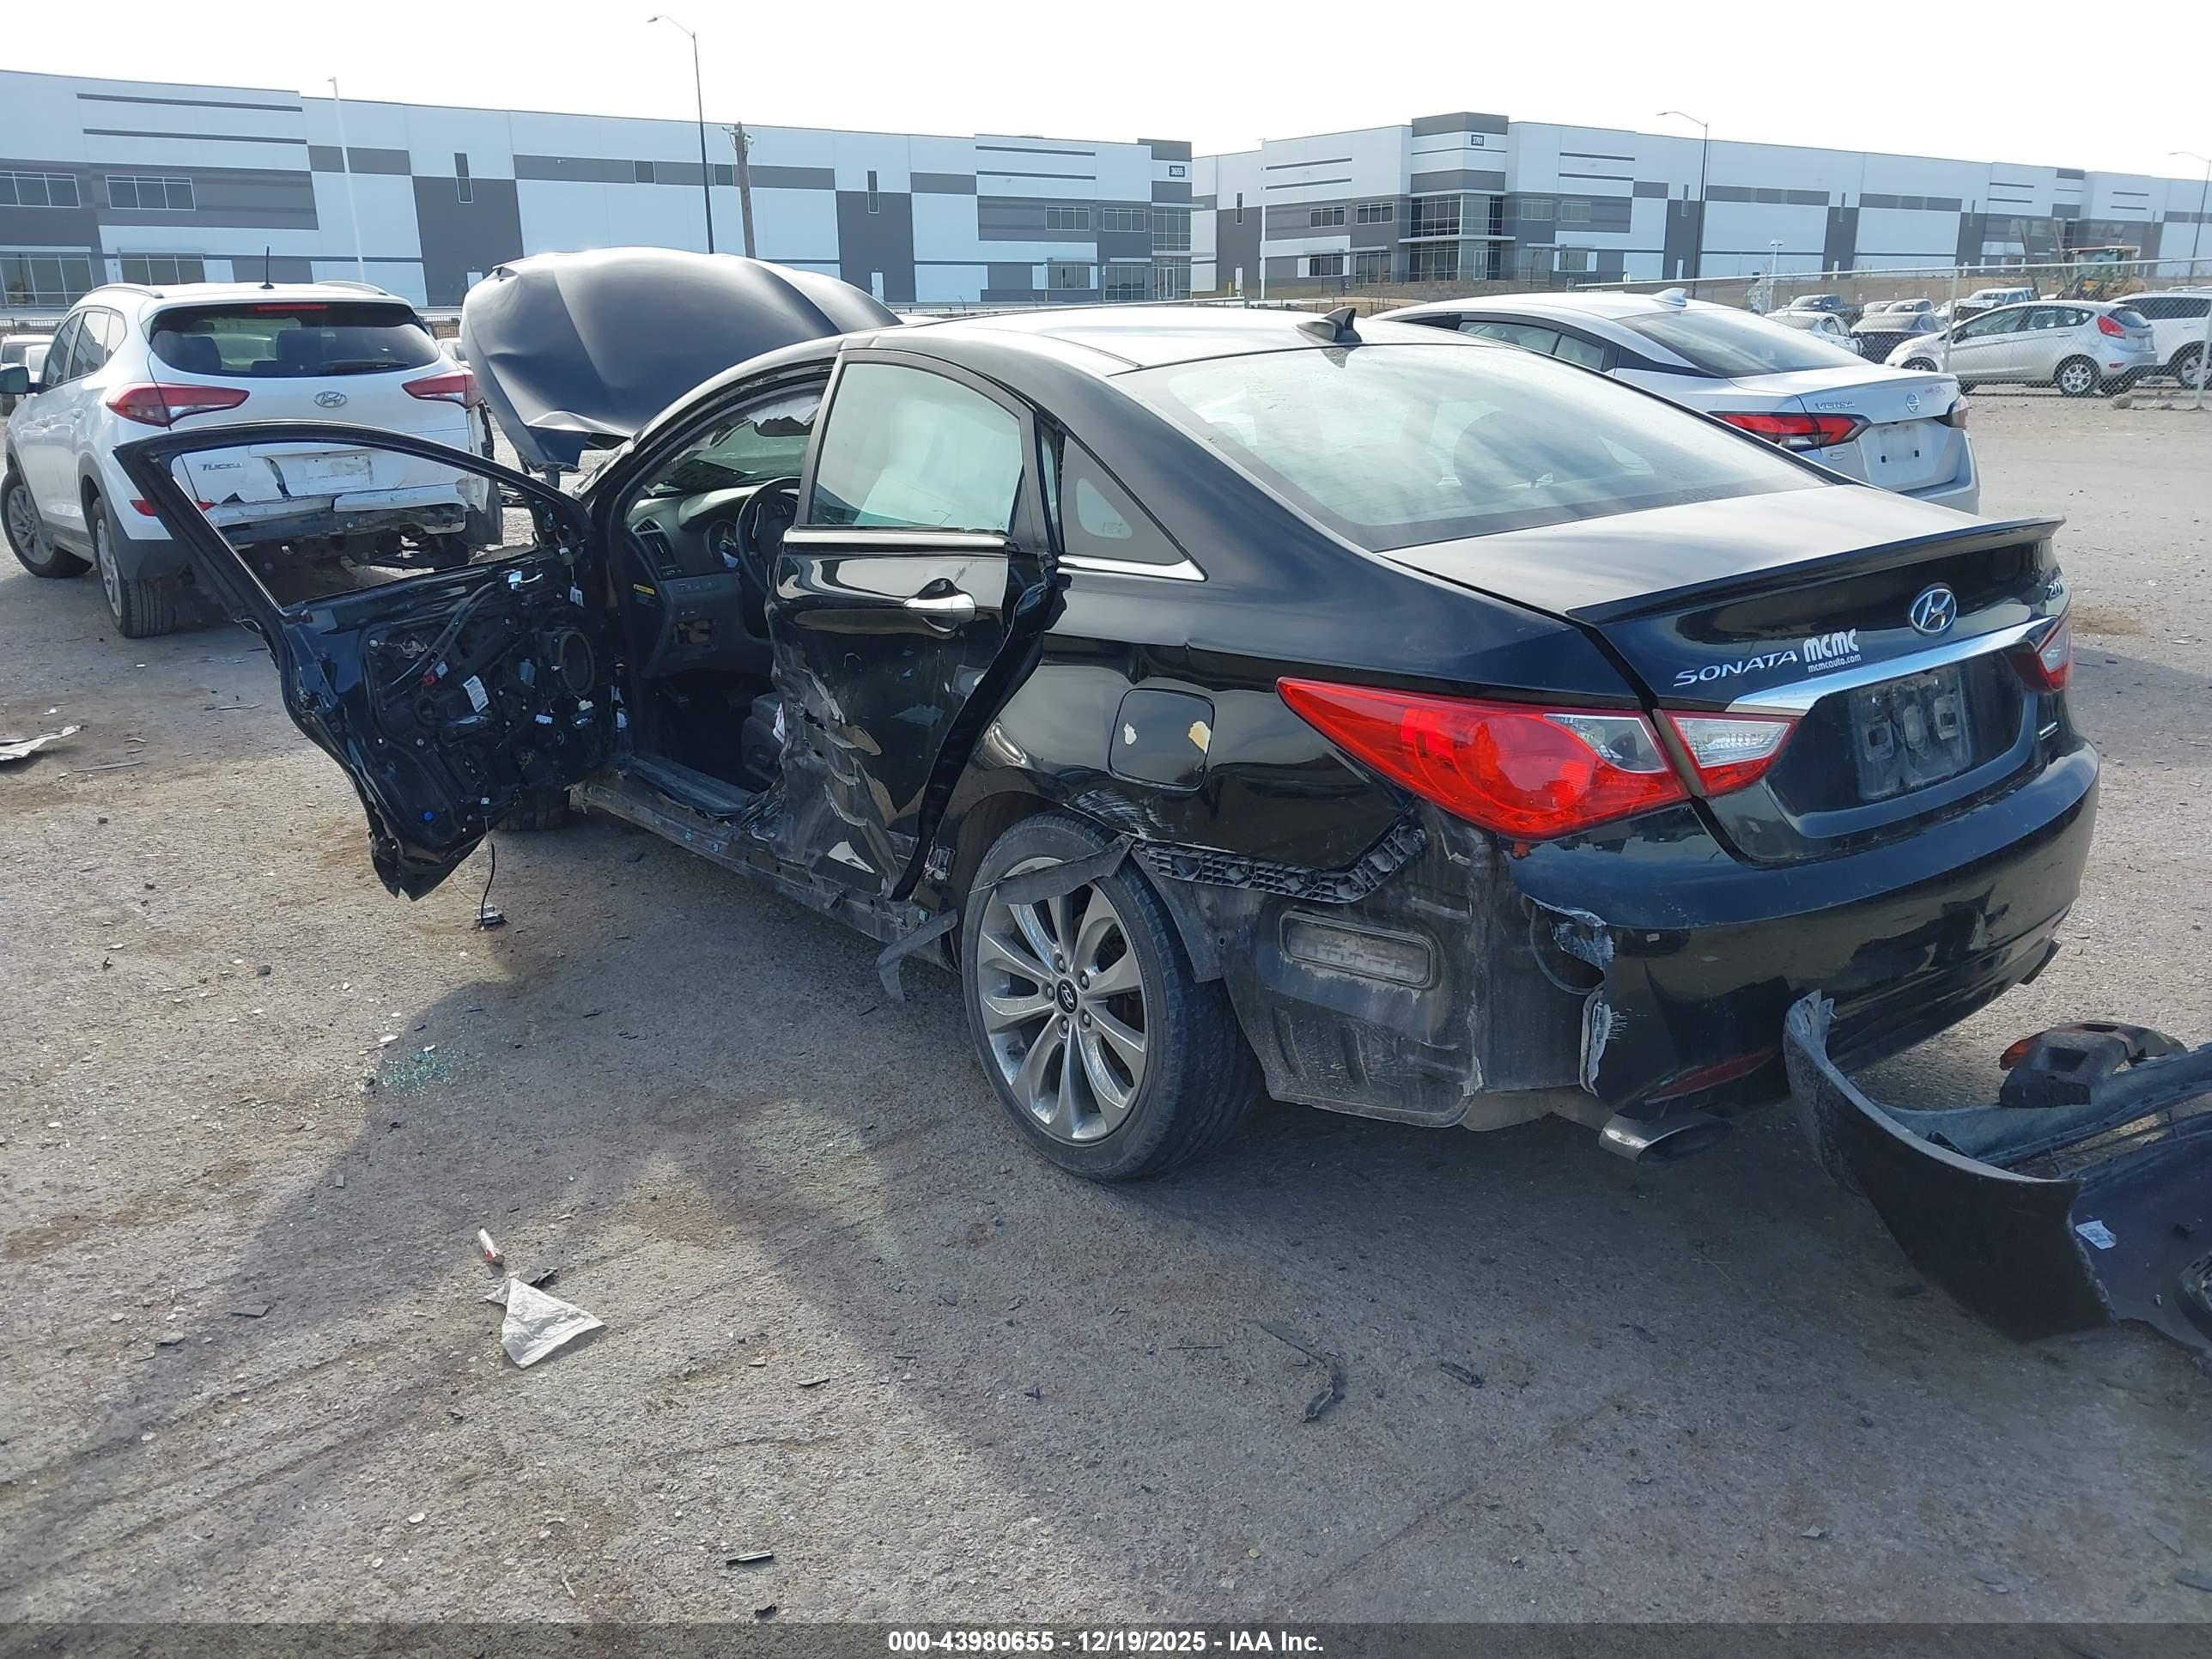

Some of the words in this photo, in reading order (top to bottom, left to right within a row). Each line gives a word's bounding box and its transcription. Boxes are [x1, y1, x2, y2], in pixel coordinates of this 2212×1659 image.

[1814, 400, 1856, 410] VERSA
[1674, 650, 1798, 688] SONATA
[1808, 653, 1862, 673] mcmcauto.com
